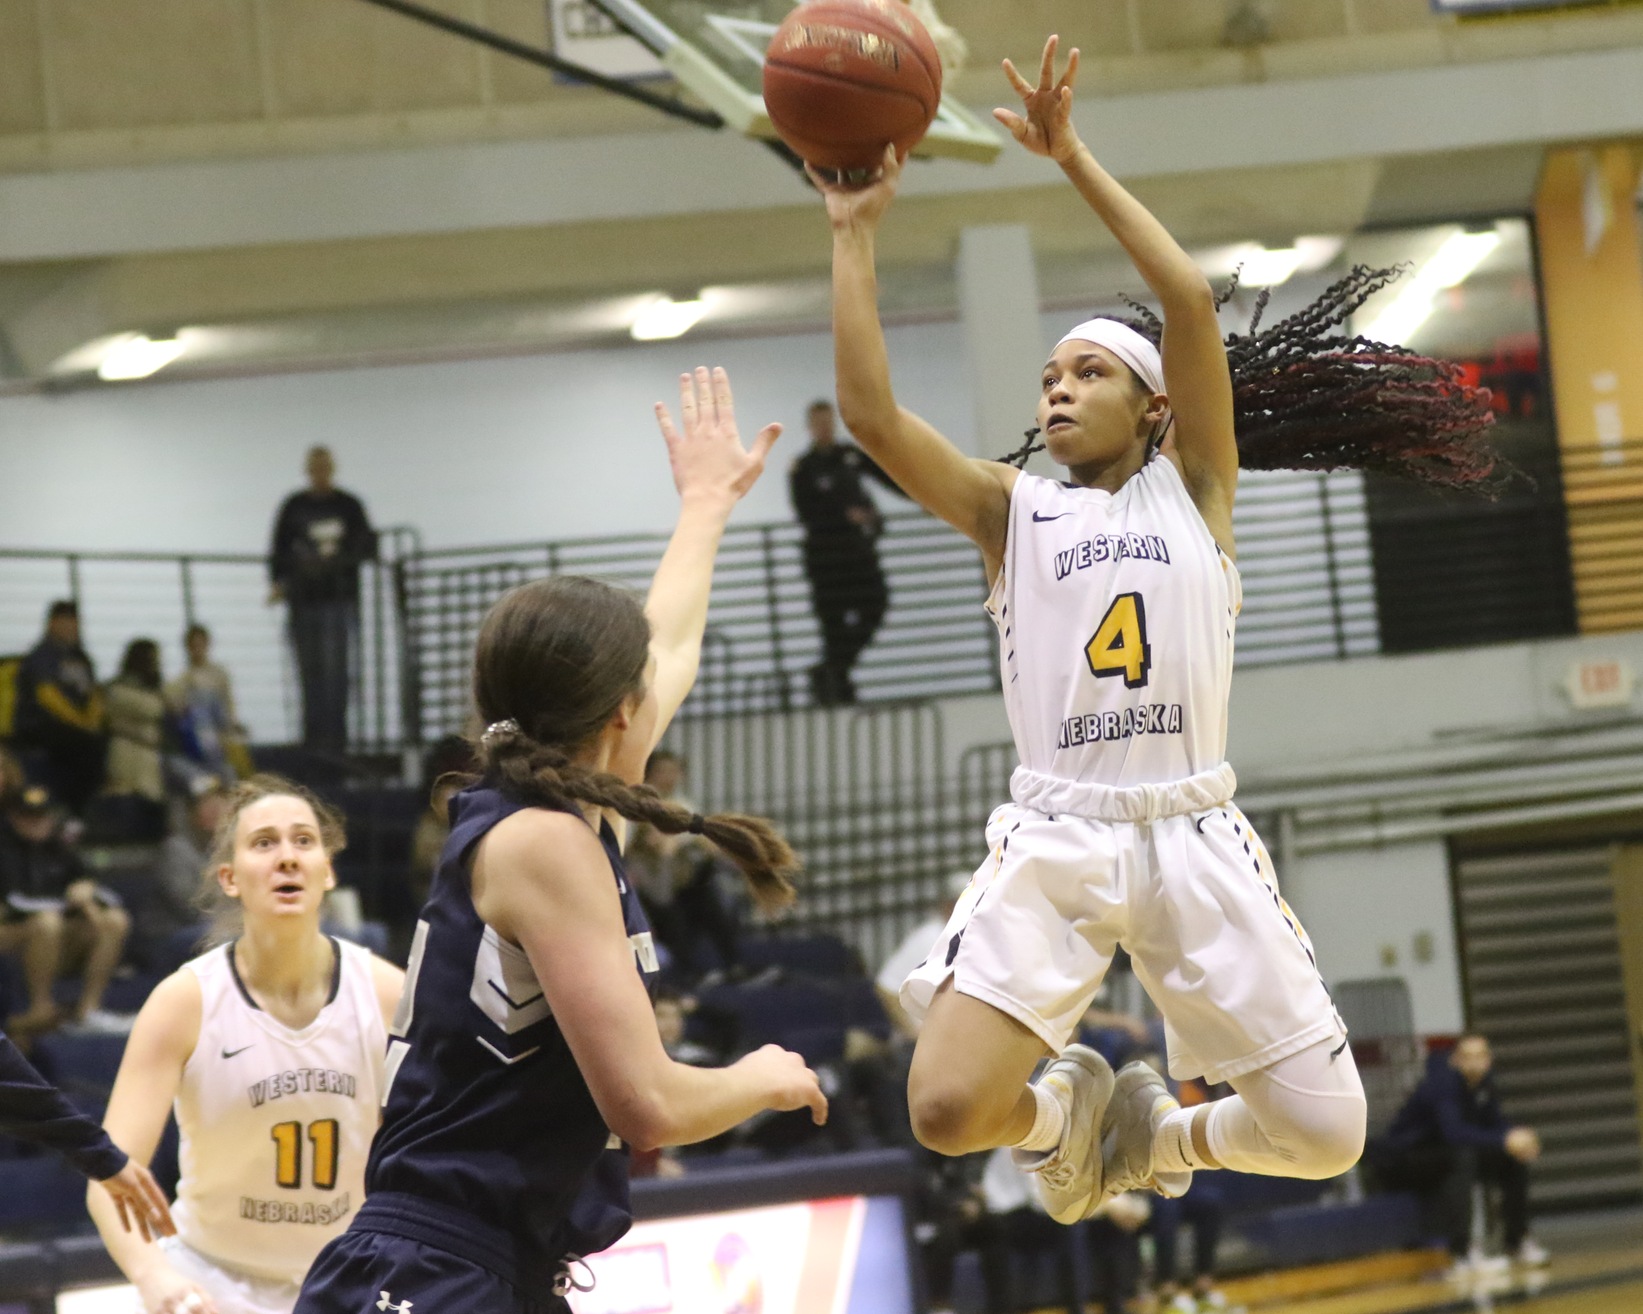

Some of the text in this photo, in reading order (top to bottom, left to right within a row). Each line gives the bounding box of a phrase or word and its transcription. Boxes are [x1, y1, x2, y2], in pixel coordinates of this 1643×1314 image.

[1084, 591, 1152, 690] 4
[248, 1068, 356, 1108] WESTERN
[271, 1118, 339, 1190] 11
